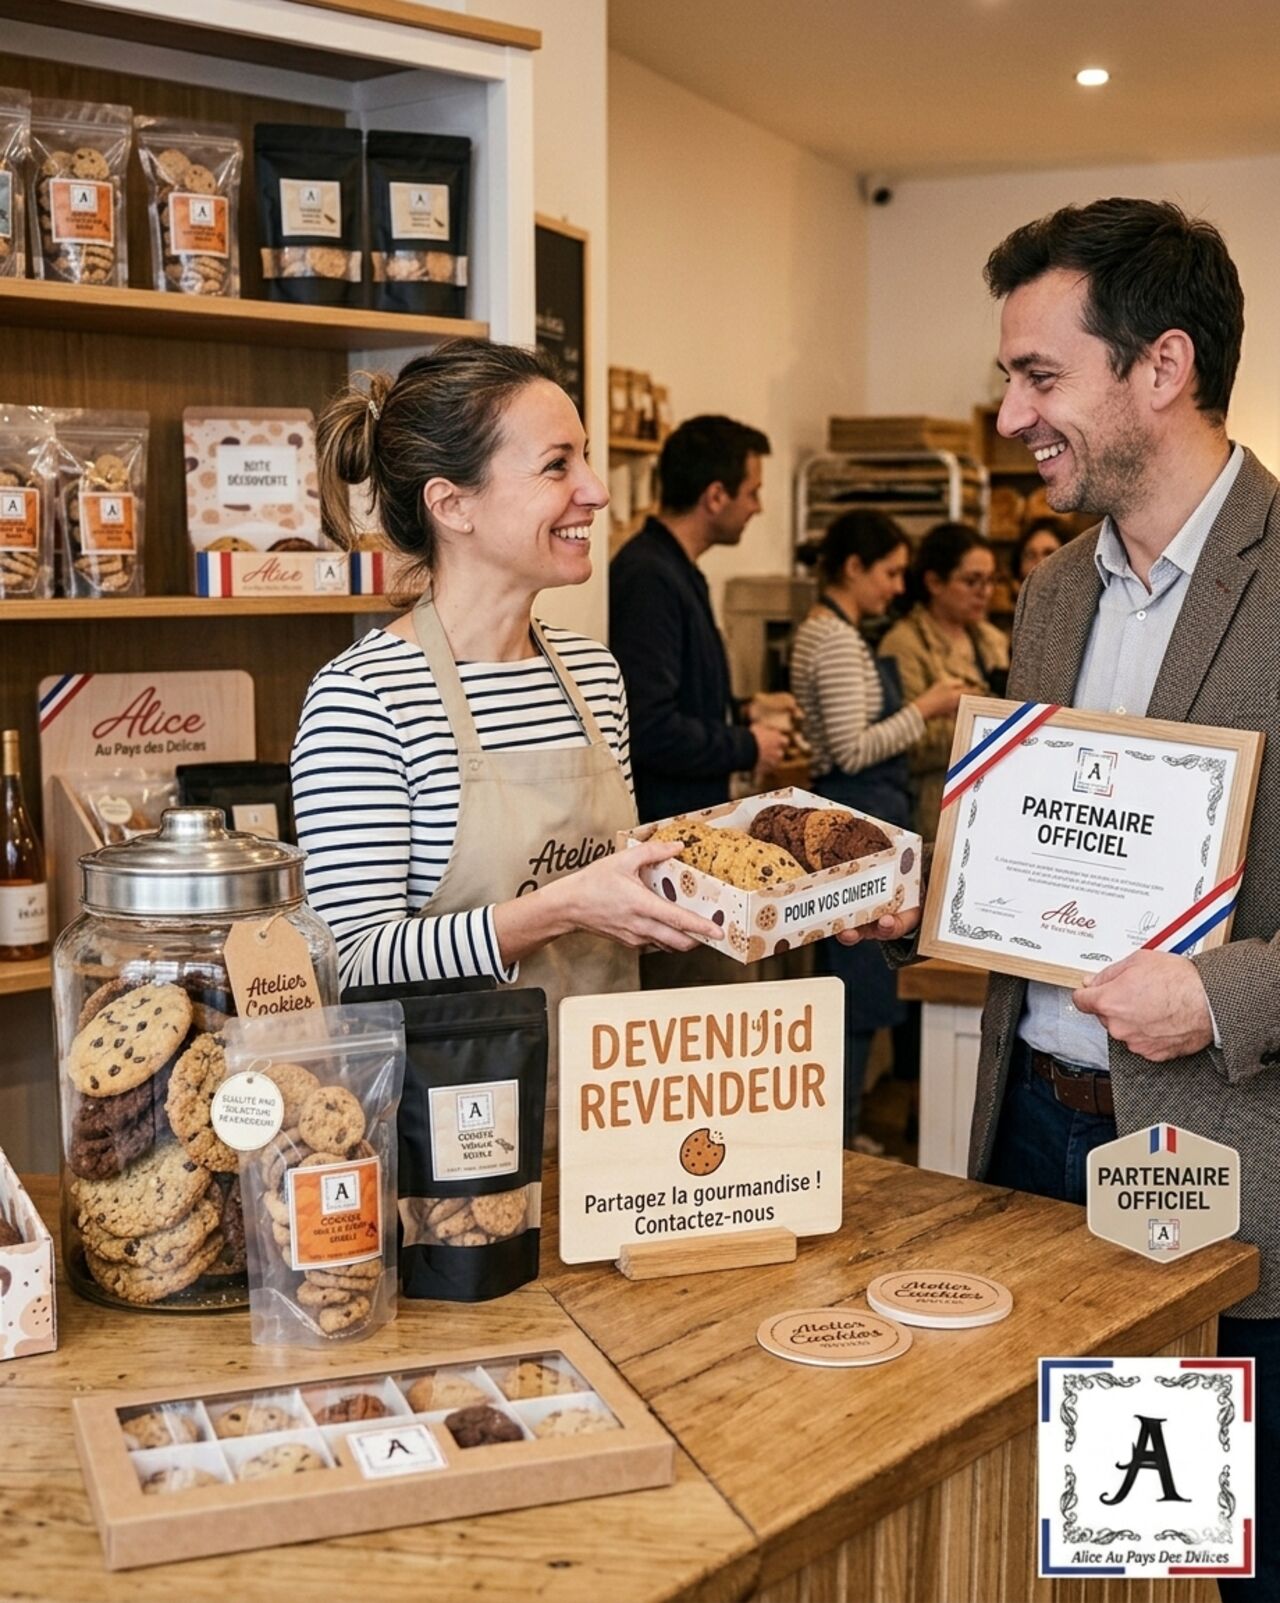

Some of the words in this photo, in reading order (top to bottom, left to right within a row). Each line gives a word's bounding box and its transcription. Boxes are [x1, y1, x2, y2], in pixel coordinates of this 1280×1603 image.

[324, 565, 336, 578] A
[92, 686, 206, 739] Alice
[95, 744, 112, 757] Au
[114, 743, 141, 758] Pays
[144, 741, 164, 754] des
[1088, 762, 1101, 780] A
[1022, 795, 1155, 835] PARTENAIRE
[1037, 824, 1128, 858] OFFICIEL
[784, 899, 815, 923] POUR
[818, 891, 840, 913] VOS
[580, 1062, 826, 1131] REVENDEUR
[469, 1102, 482, 1118] A
[1098, 1167, 1230, 1186] PARTENAIRE
[335, 1182, 350, 1200] A
[585, 1191, 666, 1214] Partagez
[672, 1186, 688, 1205] la
[693, 1174, 810, 1206] gourmandise
[815, 1170, 822, 1189] !
[1117, 1191, 1210, 1210] OFFICIEL
[635, 1205, 775, 1235] Contactez-nous
[1157, 1226, 1170, 1240] A
[387, 1439, 411, 1458] A
